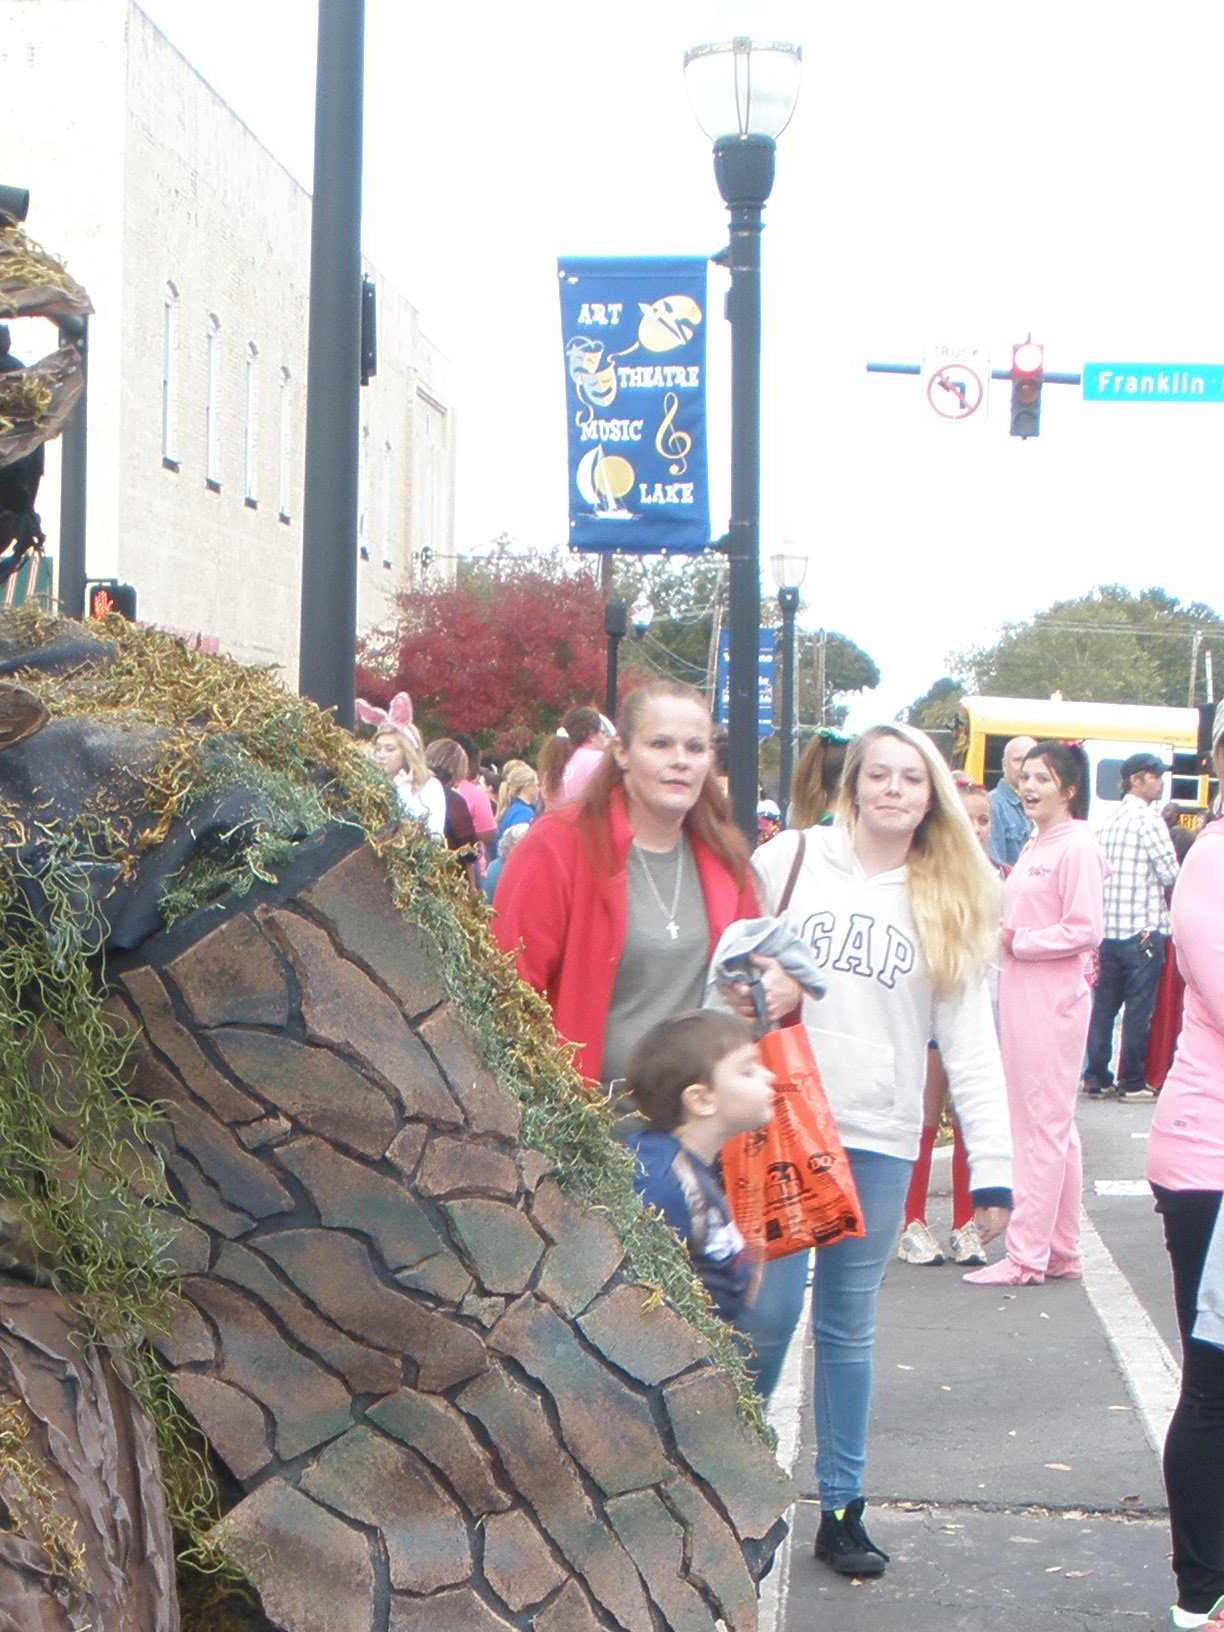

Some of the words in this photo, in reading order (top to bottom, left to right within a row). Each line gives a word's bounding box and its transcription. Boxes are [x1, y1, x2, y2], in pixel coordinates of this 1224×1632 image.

[577, 303, 623, 325] ART
[617, 366, 699, 388] THEATRE
[1097, 371, 1205, 395] Franklin
[580, 419, 644, 442] MUSIC
[639, 482, 694, 505] LAKE
[799, 909, 917, 990] GAP
